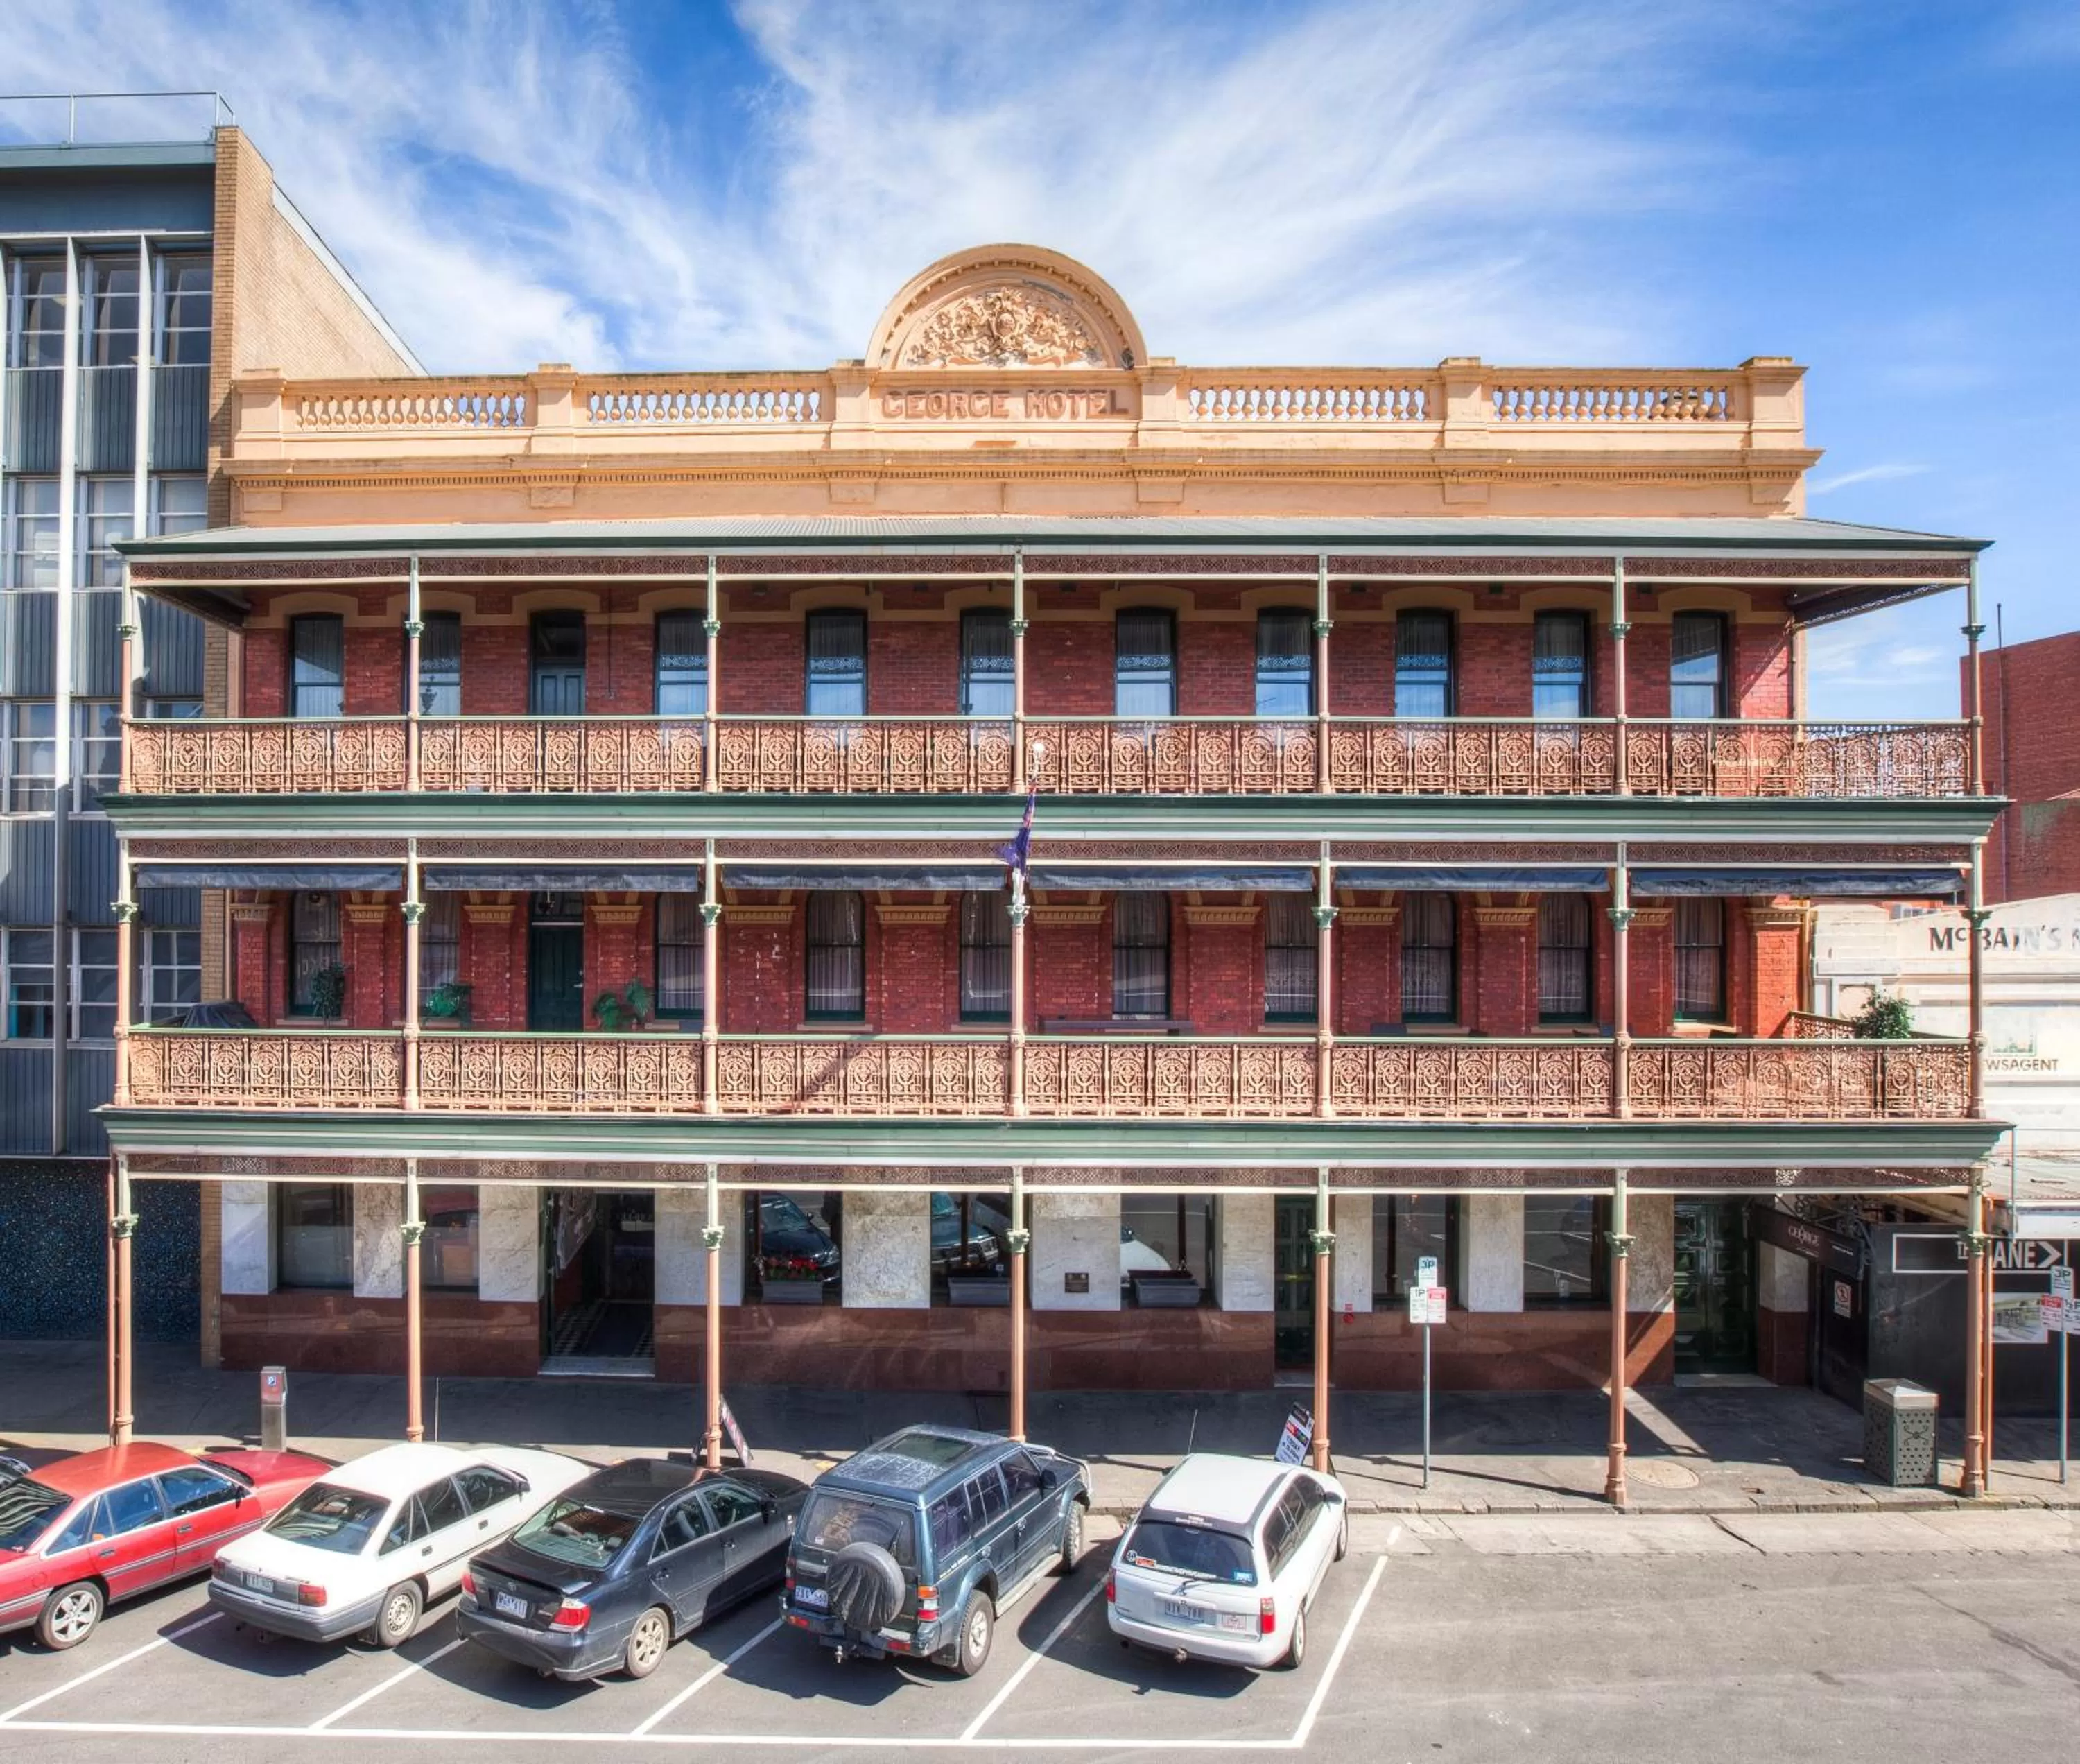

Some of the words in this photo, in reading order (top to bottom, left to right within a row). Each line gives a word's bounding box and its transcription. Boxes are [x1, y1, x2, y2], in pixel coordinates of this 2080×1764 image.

[882, 390, 1010, 419] GEORGE
[1024, 389, 1128, 419] HOTEL
[1984, 1058, 2059, 1071] WSAGENT
[1993, 1241, 2036, 1268] ANE
